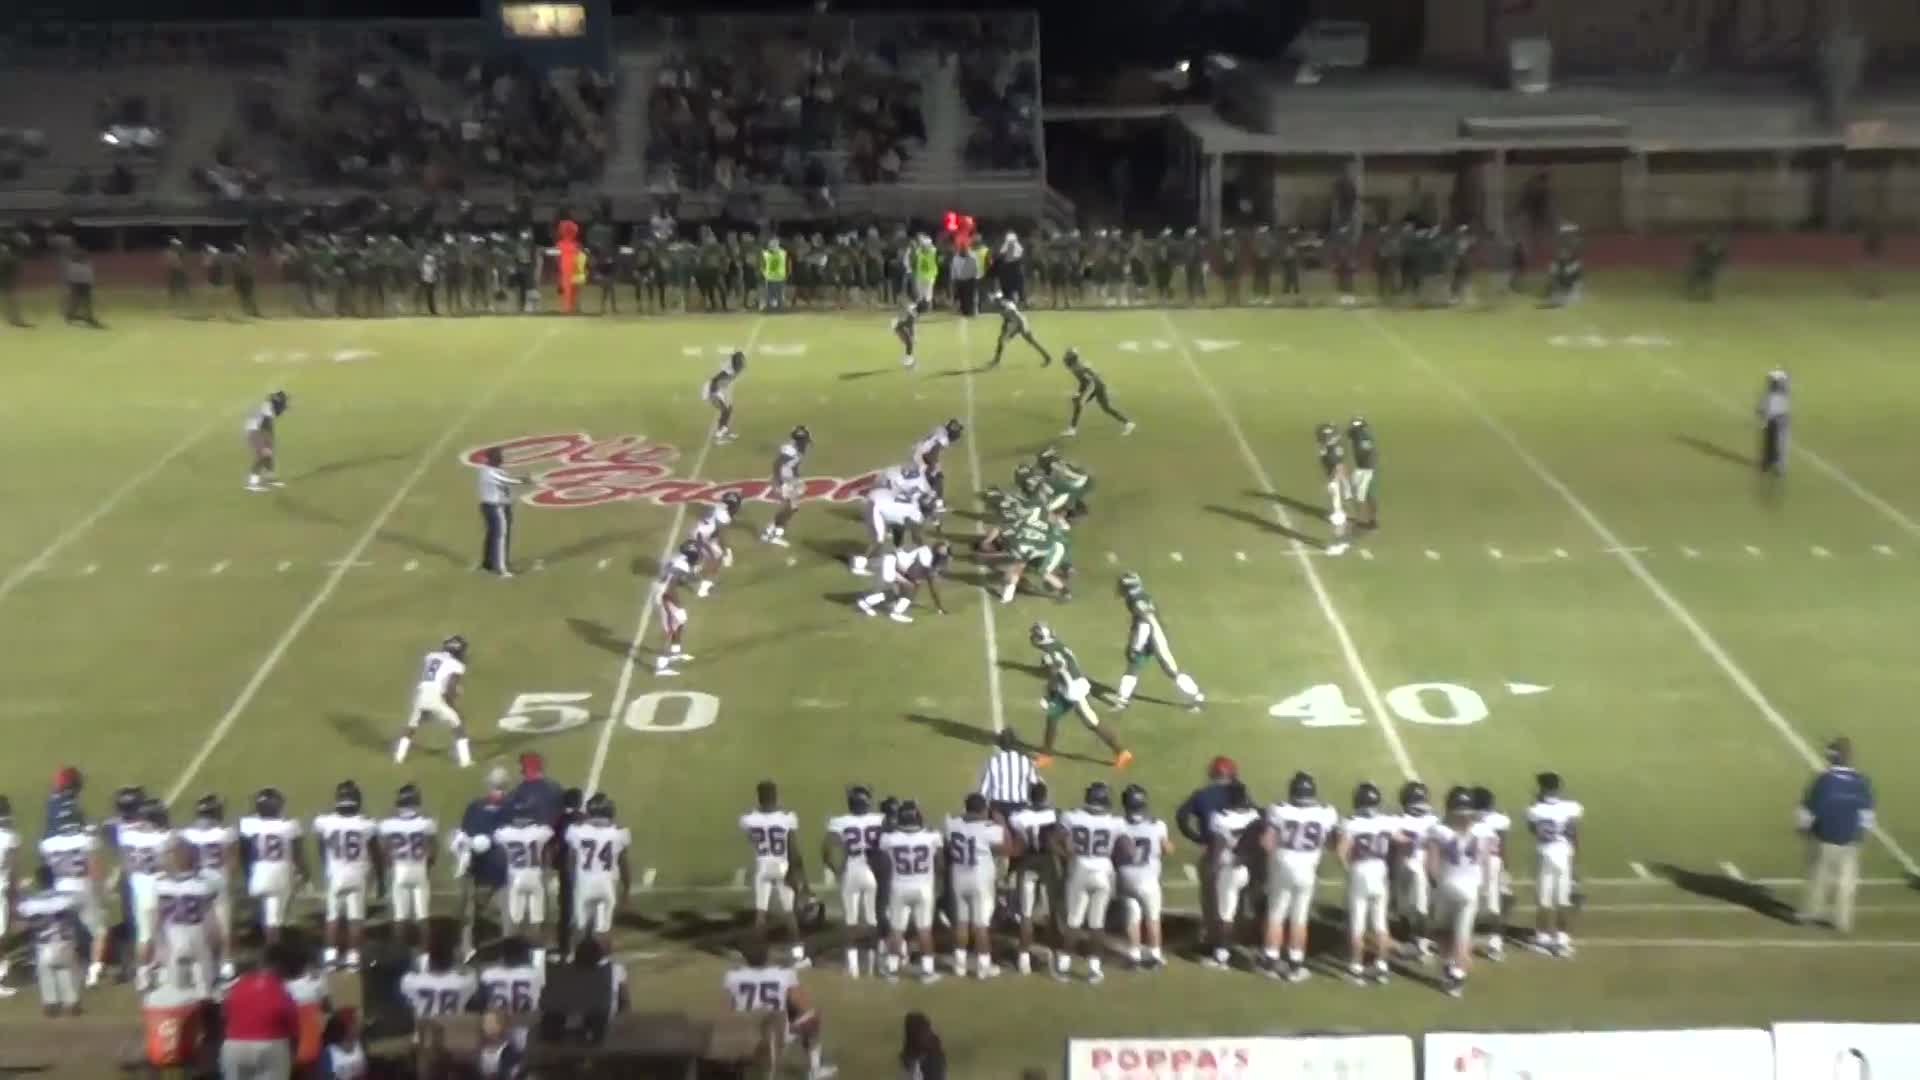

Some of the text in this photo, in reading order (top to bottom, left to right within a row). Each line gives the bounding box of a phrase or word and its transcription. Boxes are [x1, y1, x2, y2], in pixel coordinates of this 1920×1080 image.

[498, 691, 720, 734] 50
[1269, 683, 1489, 727] 40
[579, 839, 614, 872] 74
[751, 827, 786, 858] 26
[1070, 826, 1112, 857] 92
[738, 981, 780, 1011] 75
[1091, 1047, 1249, 1072] POPPA'S
